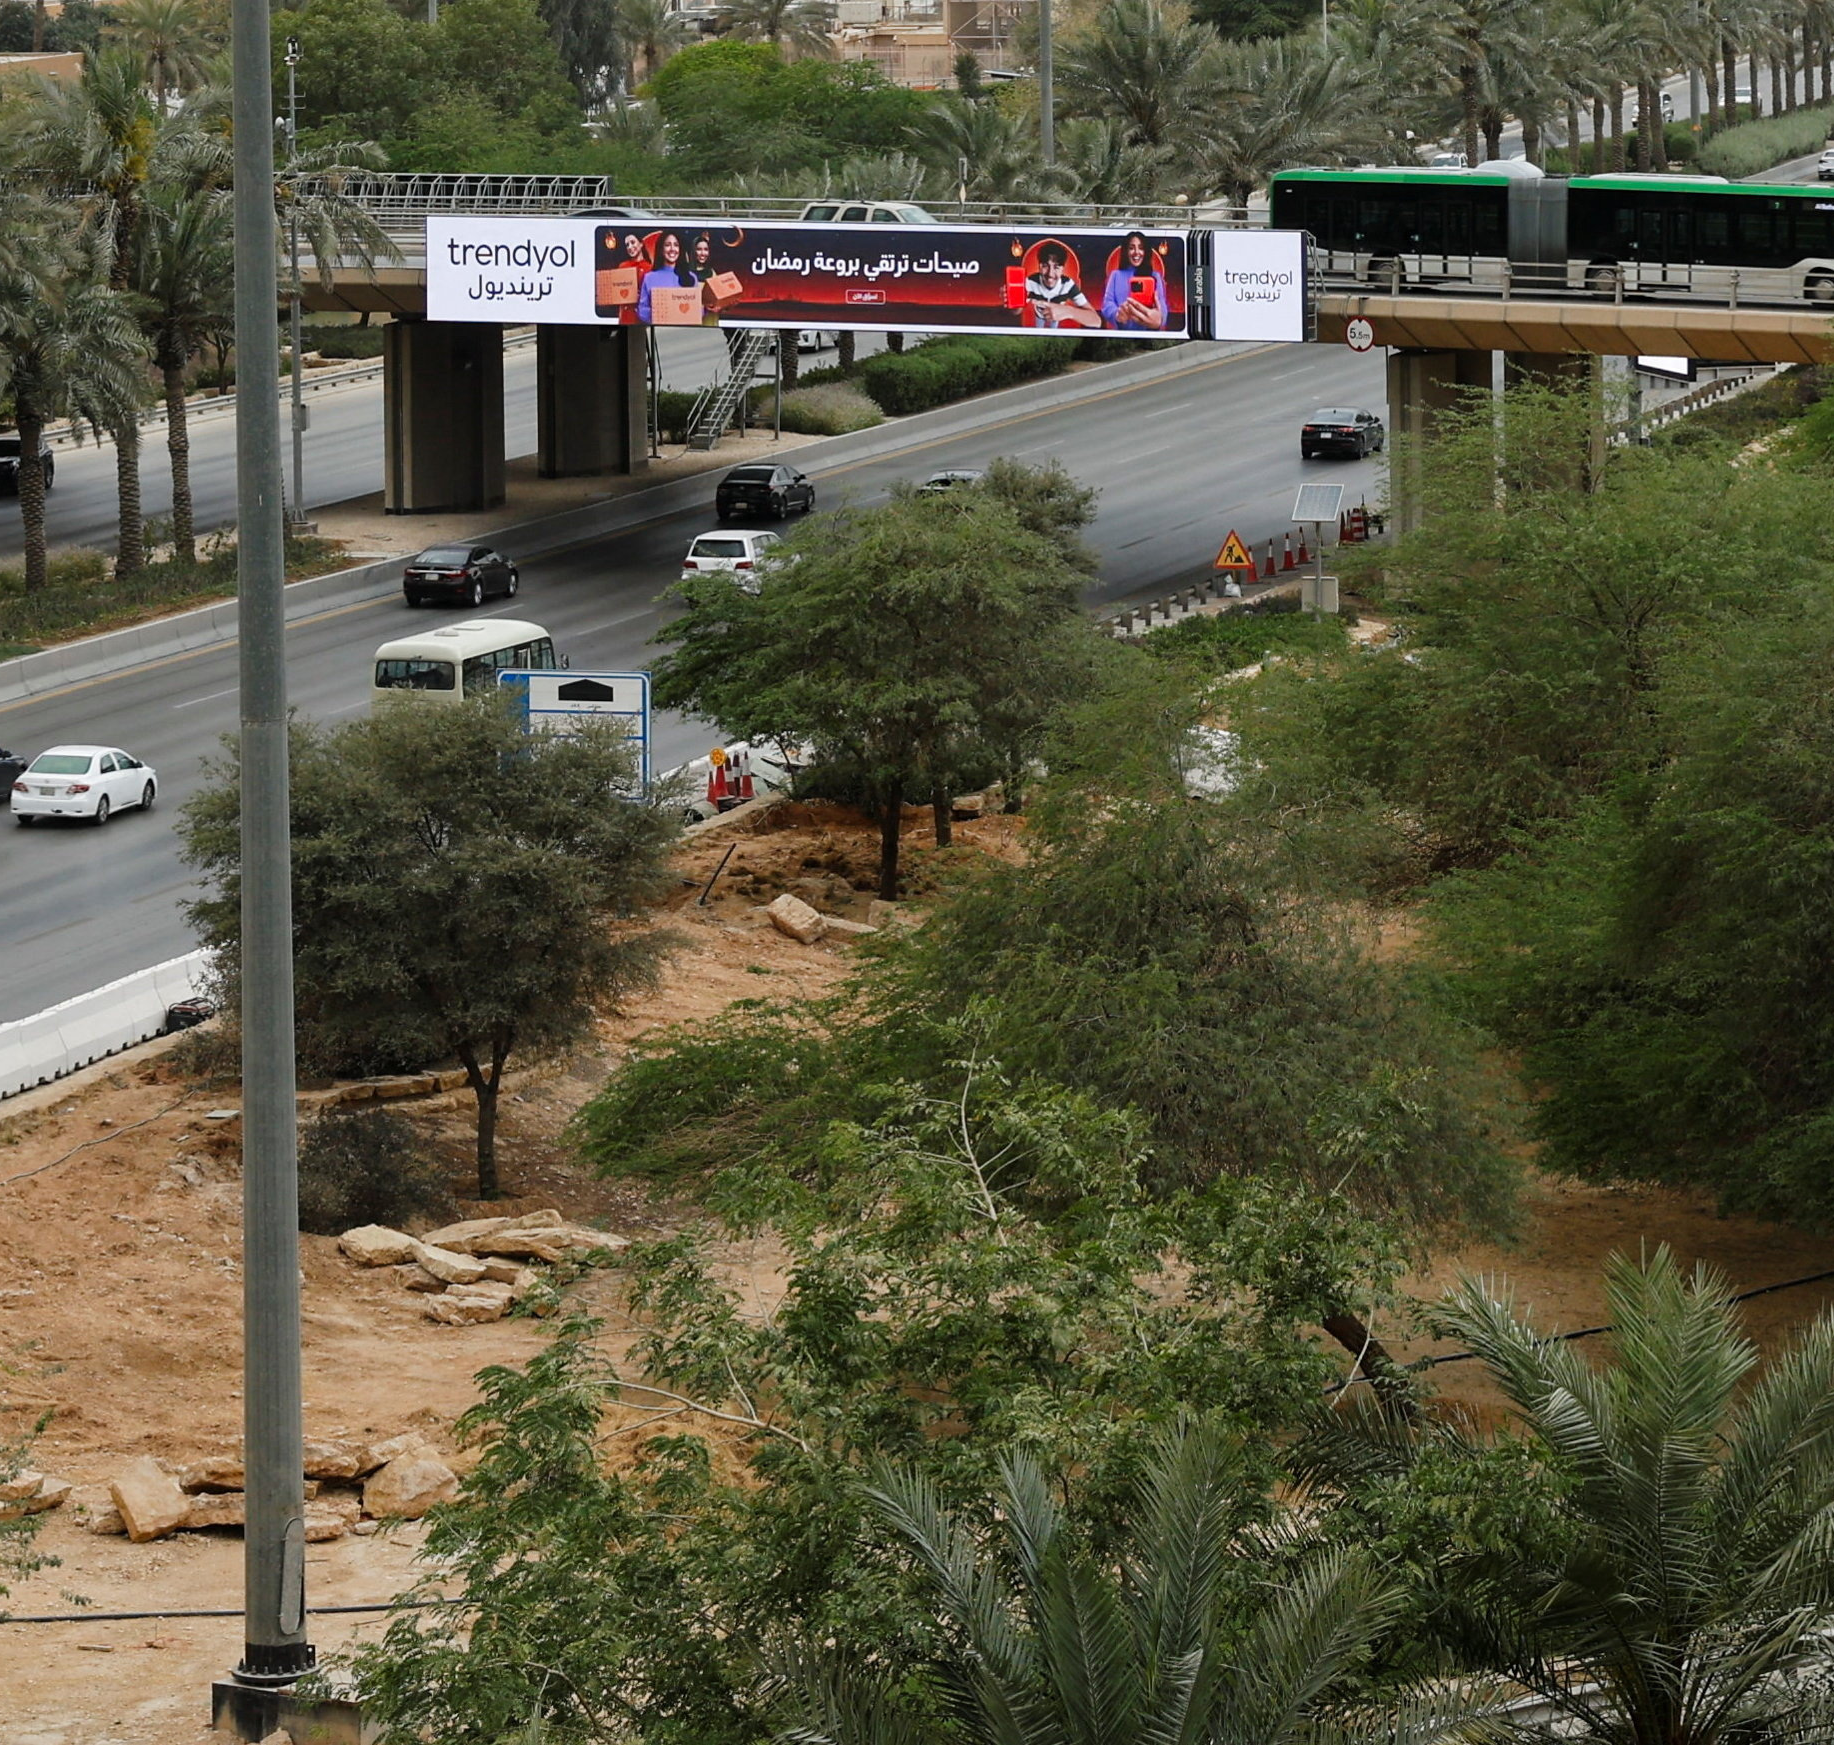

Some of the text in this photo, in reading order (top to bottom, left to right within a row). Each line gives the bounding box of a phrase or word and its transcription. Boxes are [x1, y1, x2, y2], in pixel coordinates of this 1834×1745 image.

[448, 238, 575, 272] trendyol
[751, 248, 980, 282] صيحات ترتقي بروعة رمضان
[469, 274, 554, 301] ترينديول
[1194, 268, 1203, 304] al arabia
[1225, 270, 1293, 287] trendyol
[1235, 288, 1281, 303] ترينديول
[1349, 327, 1370, 340] 5.5m
